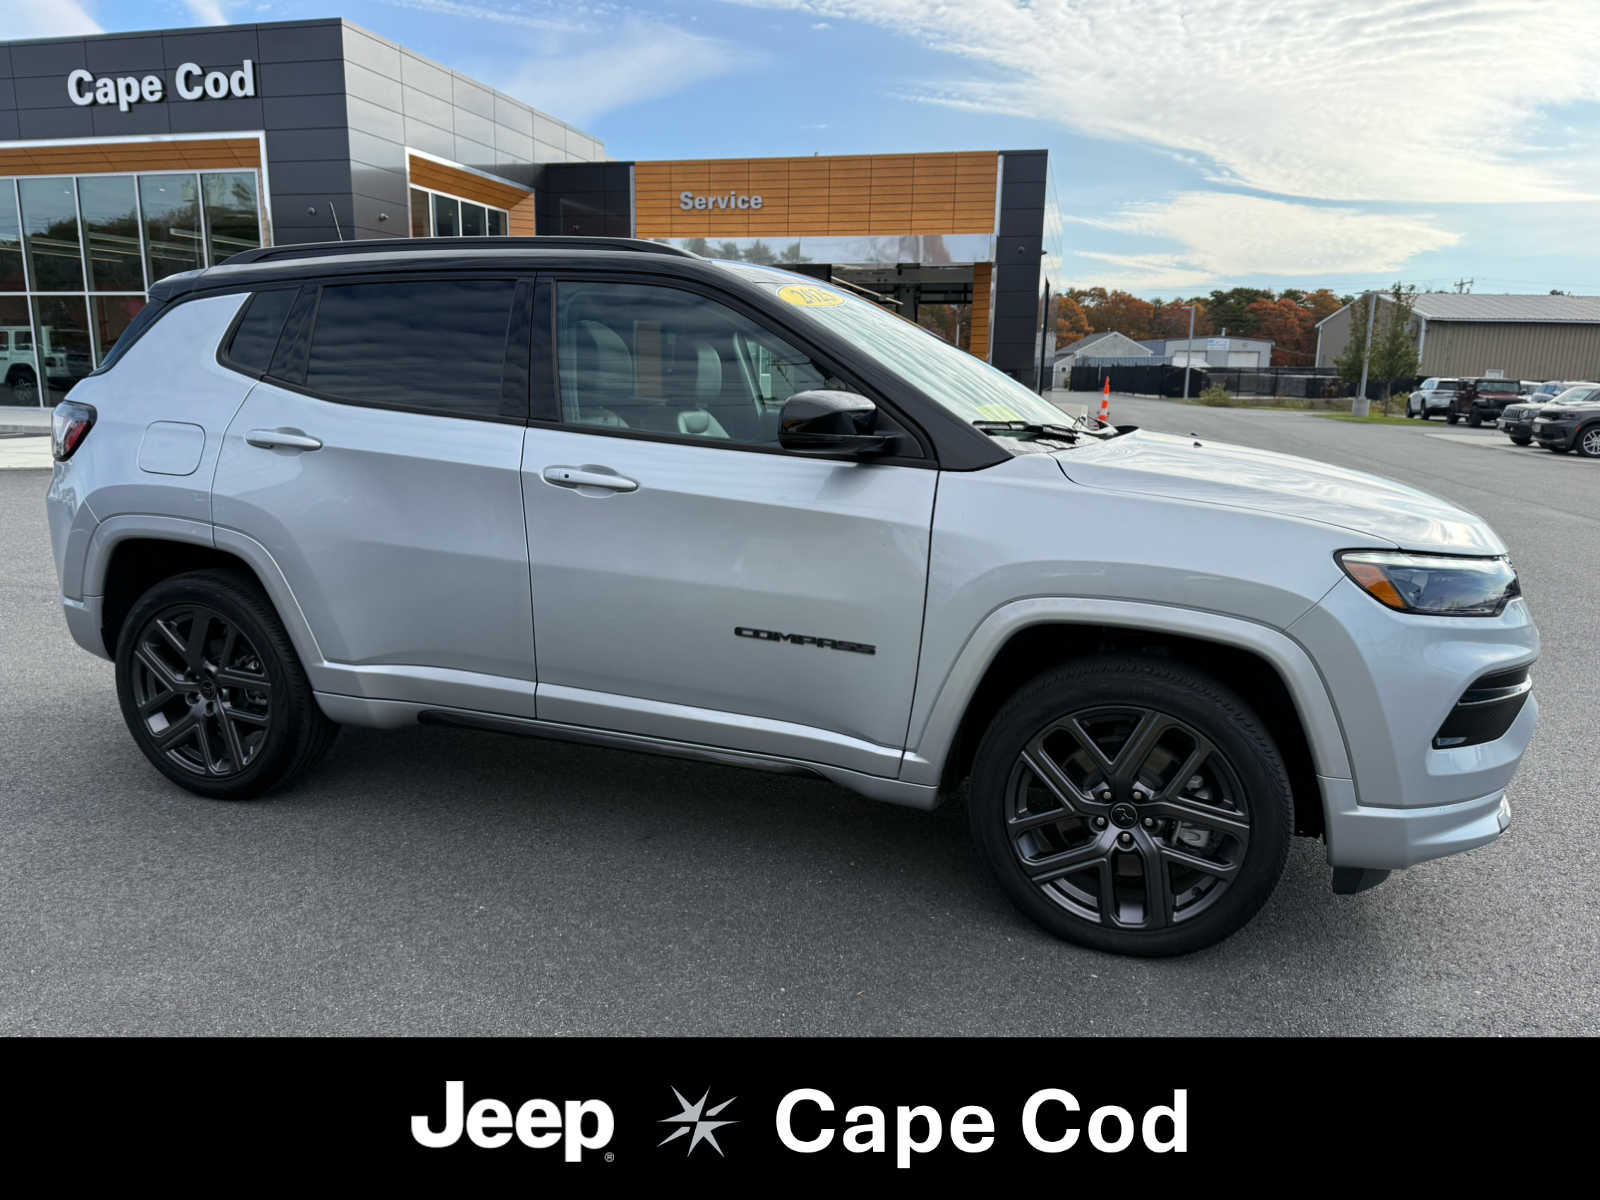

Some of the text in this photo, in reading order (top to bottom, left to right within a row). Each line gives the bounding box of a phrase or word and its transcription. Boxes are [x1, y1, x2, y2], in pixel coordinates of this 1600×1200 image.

[67, 59, 255, 112] Cape Cod
[680, 191, 763, 210] Service
[734, 626, 876, 655] COMPASS
